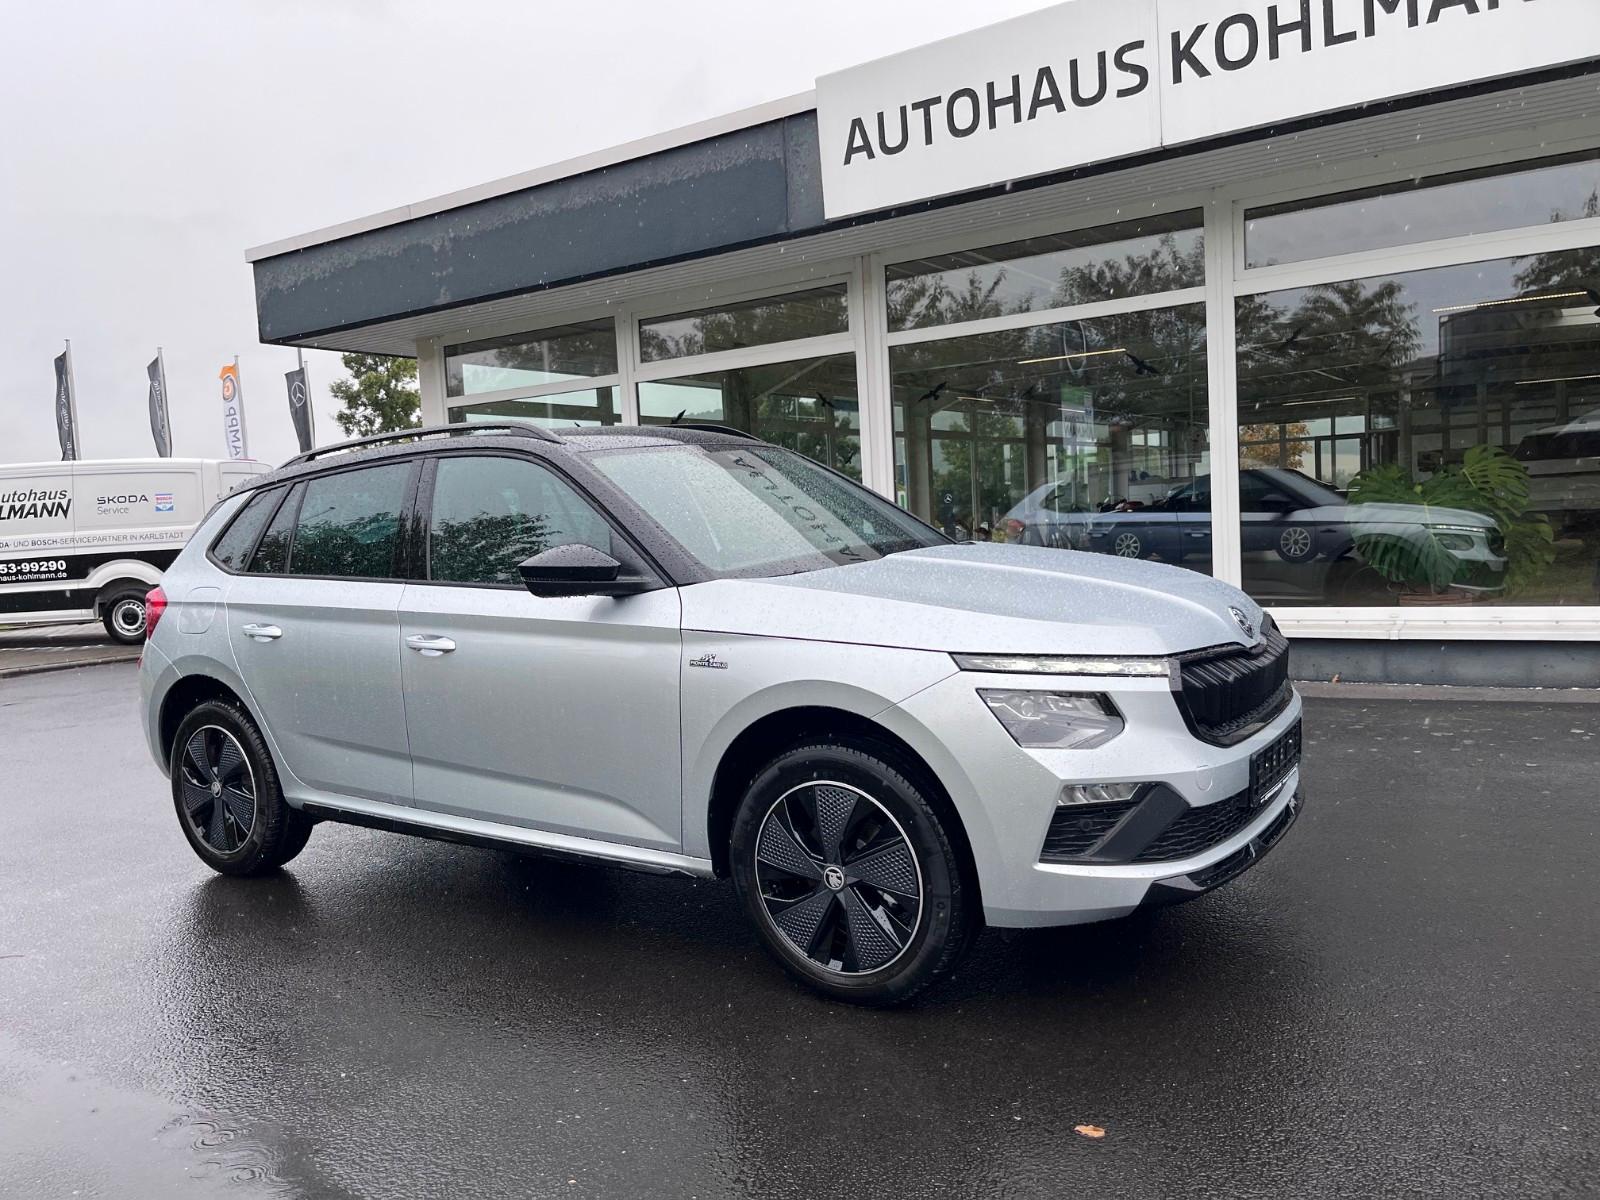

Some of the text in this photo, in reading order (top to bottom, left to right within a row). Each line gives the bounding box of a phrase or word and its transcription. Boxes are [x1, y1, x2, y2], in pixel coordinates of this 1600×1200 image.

[843, 0, 1536, 167] AUTOHAUS KOHLM
[1, 489, 68, 503] utohaus
[0, 498, 72, 520] LMANN
[97, 506, 129, 515] Service
[13, 540, 29, 548] UND
[139, 531, 184, 540] KARLSTADT
